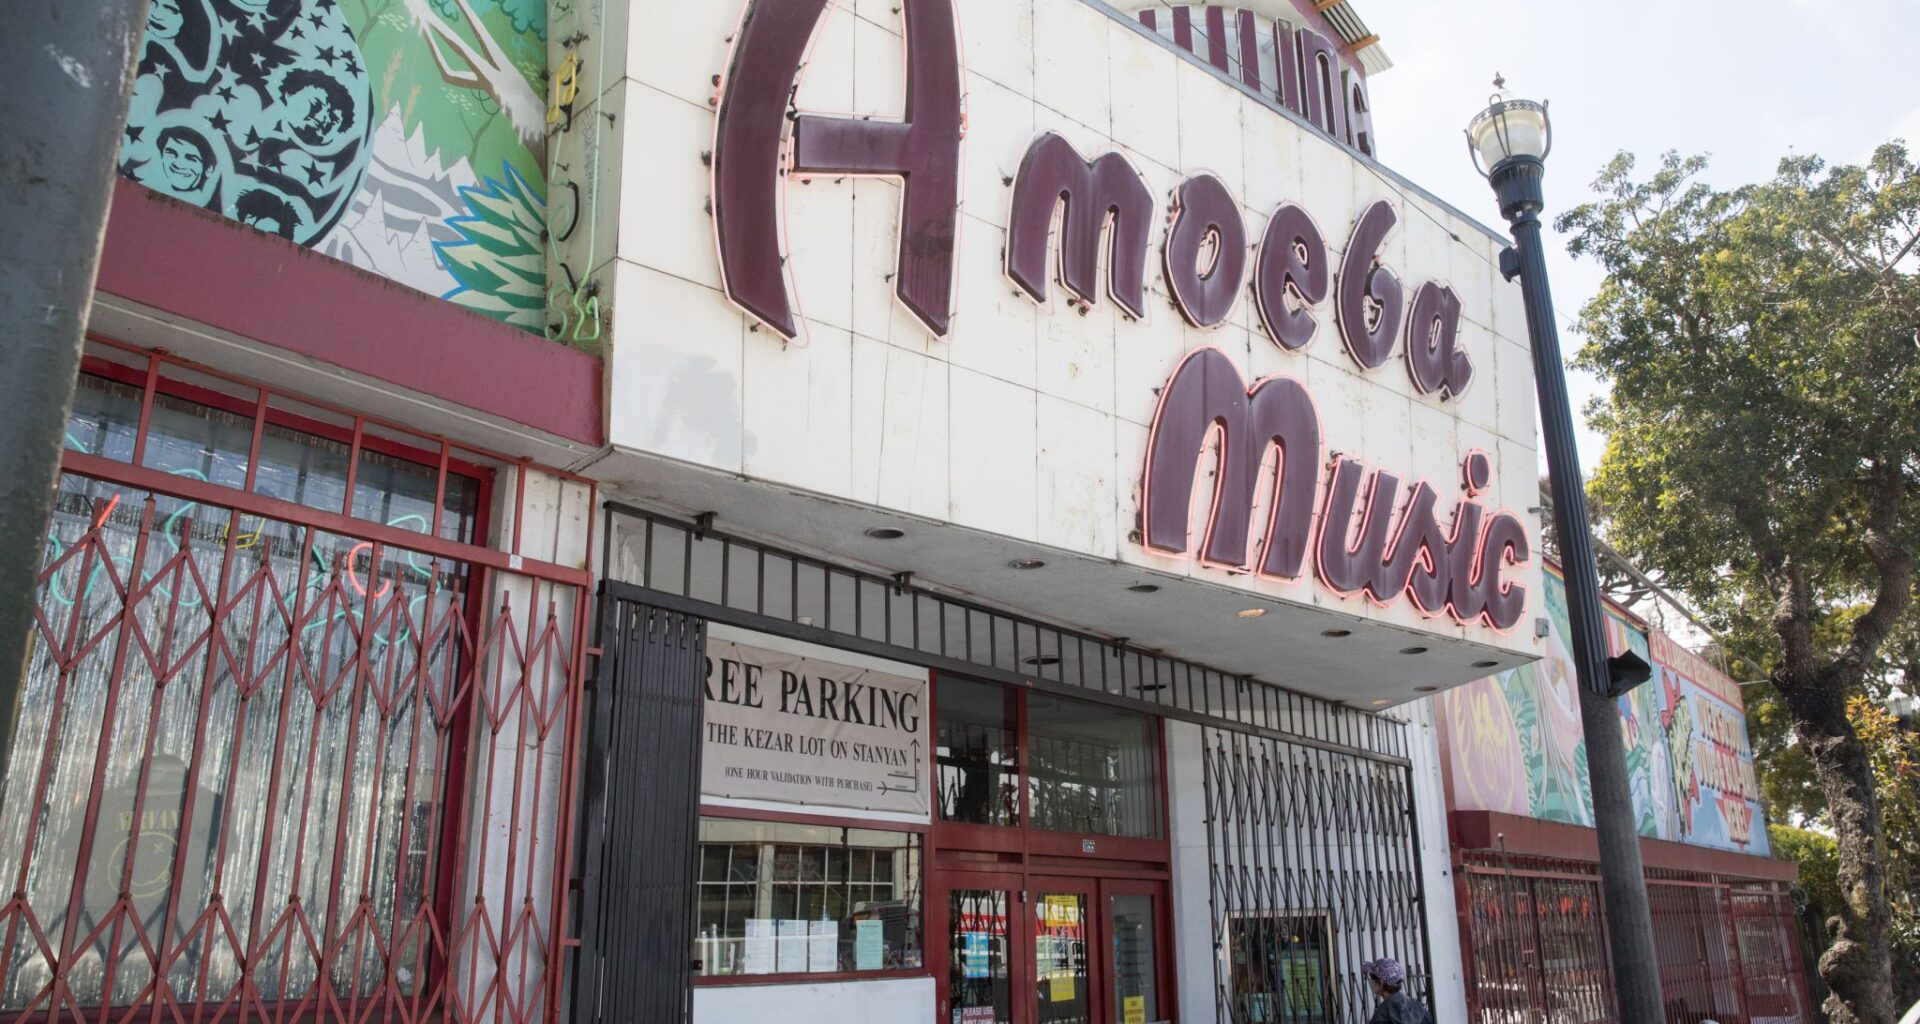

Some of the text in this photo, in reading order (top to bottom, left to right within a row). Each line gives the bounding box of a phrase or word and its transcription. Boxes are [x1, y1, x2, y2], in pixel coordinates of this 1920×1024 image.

[710, 0, 1475, 398] Amoeba
[1142, 345, 1532, 635] Music
[704, 657, 919, 733] REE PARKING
[707, 722, 907, 767] THE KEZAR LOT ON STANYAN
[725, 766, 873, 792] (ONE HOUR VALIDATION WITH PURCHASE)
[963, 1006, 994, 1016] PLEASE USE
